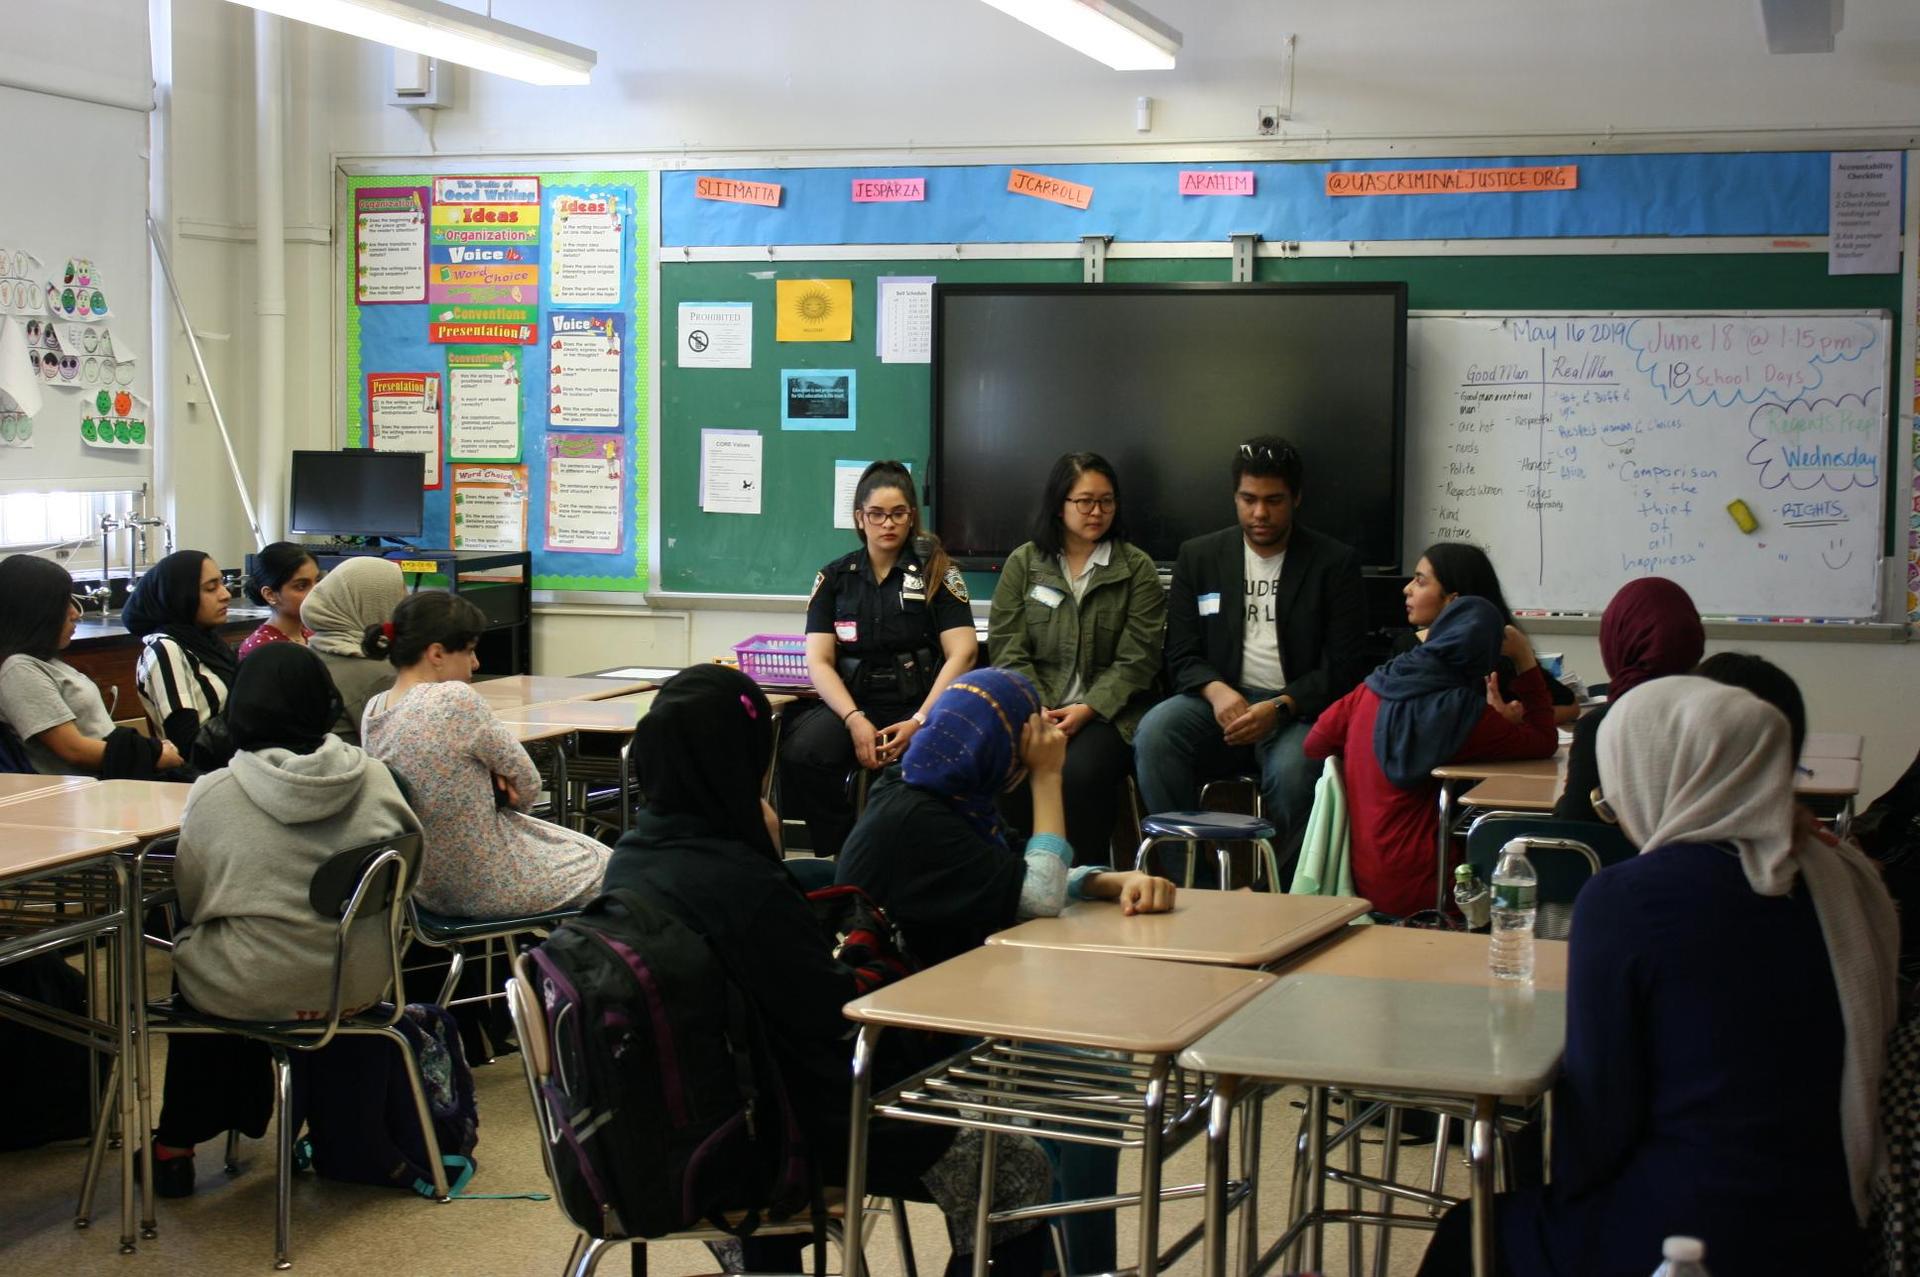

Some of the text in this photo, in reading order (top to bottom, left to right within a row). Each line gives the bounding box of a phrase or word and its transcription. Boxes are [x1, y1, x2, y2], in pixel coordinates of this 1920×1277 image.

[1847, 172, 1883, 180] Checklist
[457, 181, 472, 189] The
[1014, 174, 1083, 203] JCARROLL
[445, 190, 535, 202] Good Writing
[561, 200, 605, 212] Ideas
[463, 208, 518, 223] Ideas
[446, 229, 525, 242] Organization
[449, 246, 504, 264] Voice
[453, 266, 529, 284] Word Choice
[453, 307, 527, 320] Conventions
[690, 312, 741, 321] PROHIBITED
[552, 315, 590, 332] Voice
[438, 325, 518, 339] Presentation
[1513, 321, 1626, 349] May 16 2019
[1648, 321, 1702, 353] June
[1711, 323, 1733, 351] 18
[1747, 326, 1769, 355] @
[1820, 333, 1852, 356] pm
[1552, 350, 1614, 380] Real Man
[1467, 365, 1529, 383] Good Man
[1668, 362, 1805, 390] 18 School Days
[373, 381, 424, 393] Presentation
[1781, 446, 1878, 474] Wednesday
[459, 471, 481, 479] Word
[1669, 481, 1697, 495] the
[1638, 501, 1693, 517] thief
[1650, 519, 1671, 534] of
